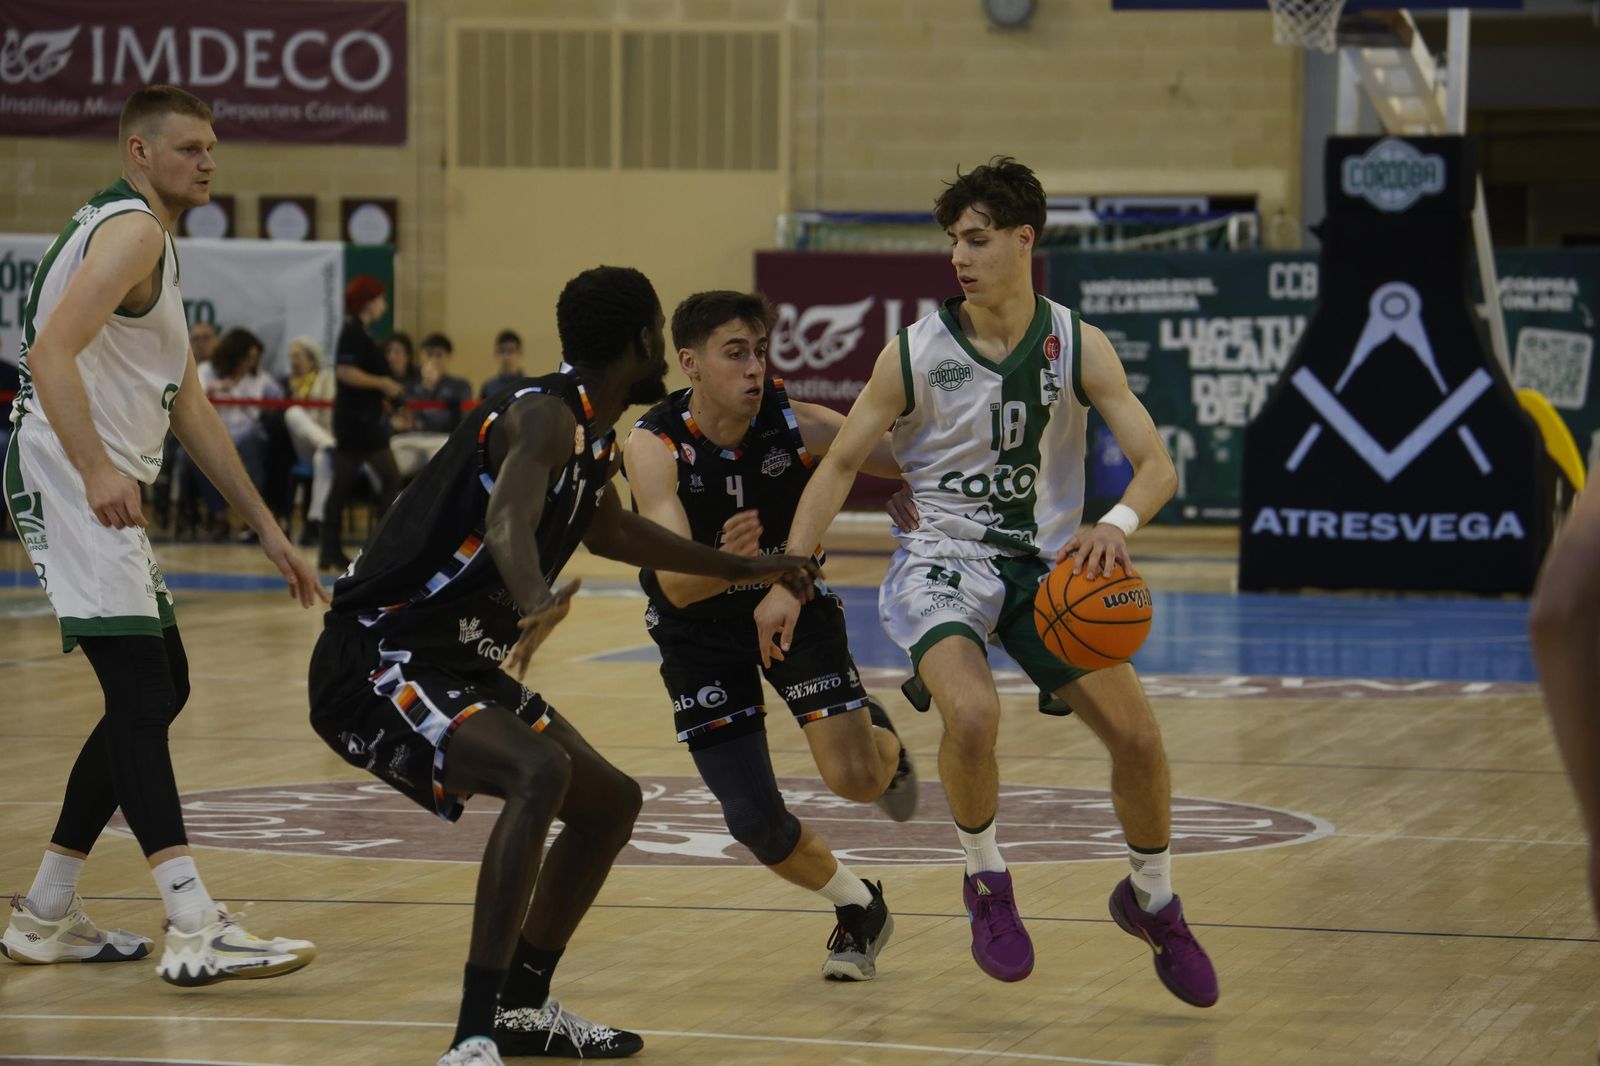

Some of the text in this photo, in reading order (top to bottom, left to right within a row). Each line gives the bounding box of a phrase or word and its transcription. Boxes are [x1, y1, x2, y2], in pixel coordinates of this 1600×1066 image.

[90, 25, 392, 92] IMDECO
[1159, 316, 1254, 350] LUCE
[990, 401, 1027, 451] 18
[725, 474, 744, 508] 4
[1252, 507, 1525, 542] ATRESVEGA
